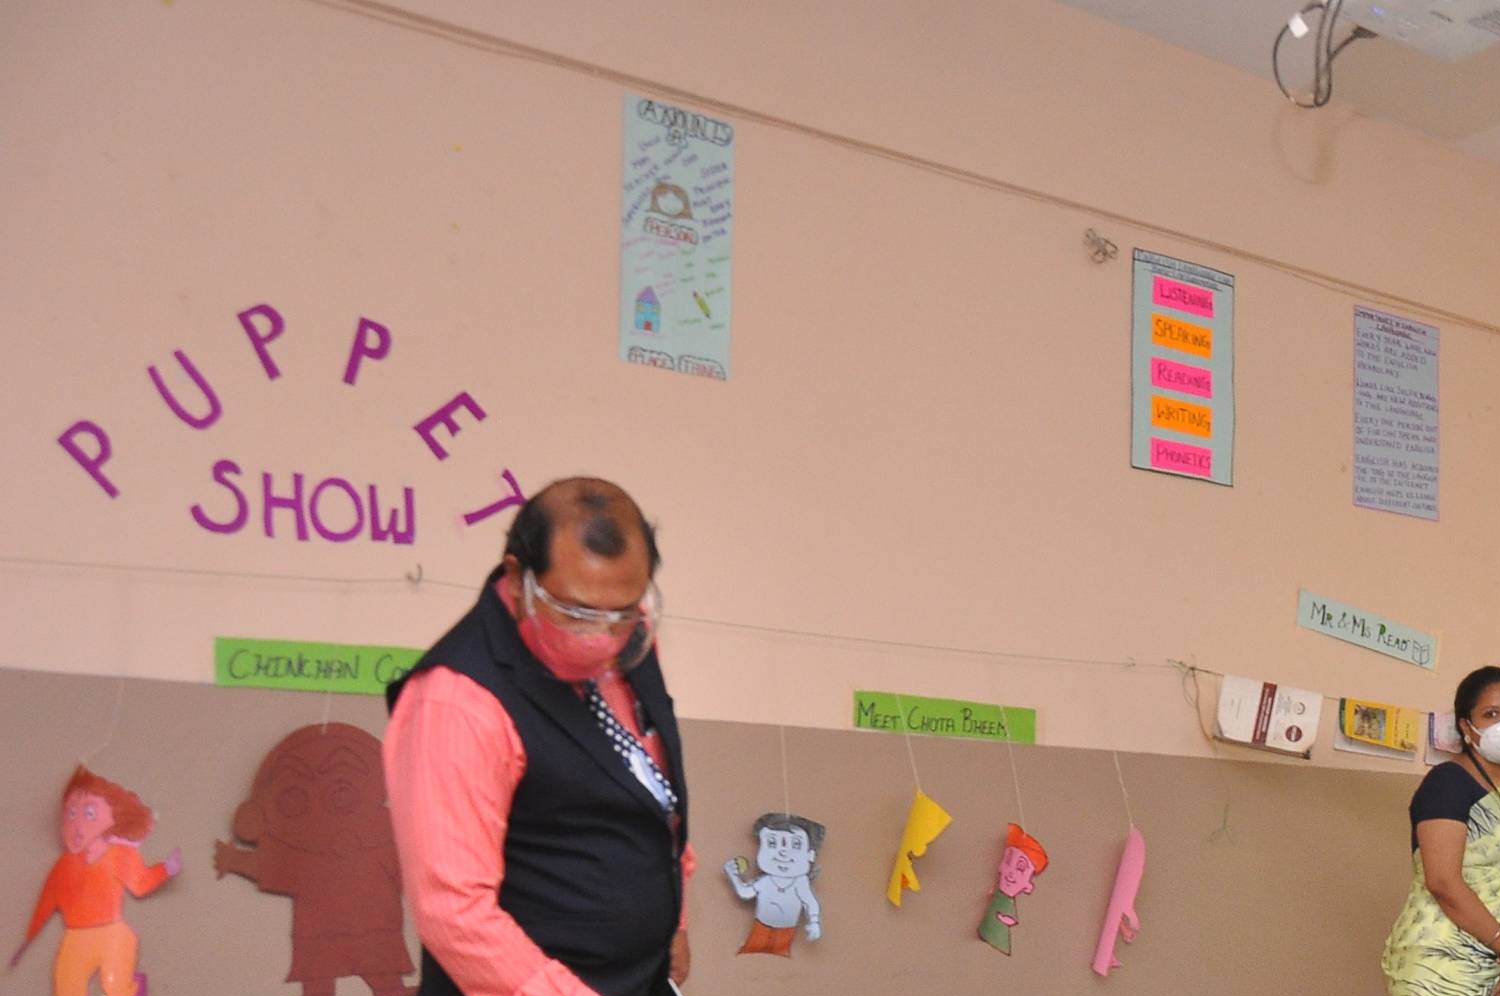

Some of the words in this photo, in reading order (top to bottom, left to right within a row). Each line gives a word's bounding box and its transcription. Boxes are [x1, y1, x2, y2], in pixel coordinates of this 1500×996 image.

[1159, 284, 1213, 312] LISTENING
[1154, 318, 1211, 350] SPEAKING
[1157, 362, 1211, 392] READING
[57, 303, 527, 525] PUPPET
[1155, 403, 1211, 433] WRITING
[1156, 444, 1212, 470] PHONETICS
[189, 458, 415, 545] SHOW
[1377, 622, 1409, 652] READ
[856, 700, 900, 729] MEET
[907, 705, 955, 732] CHOTA
